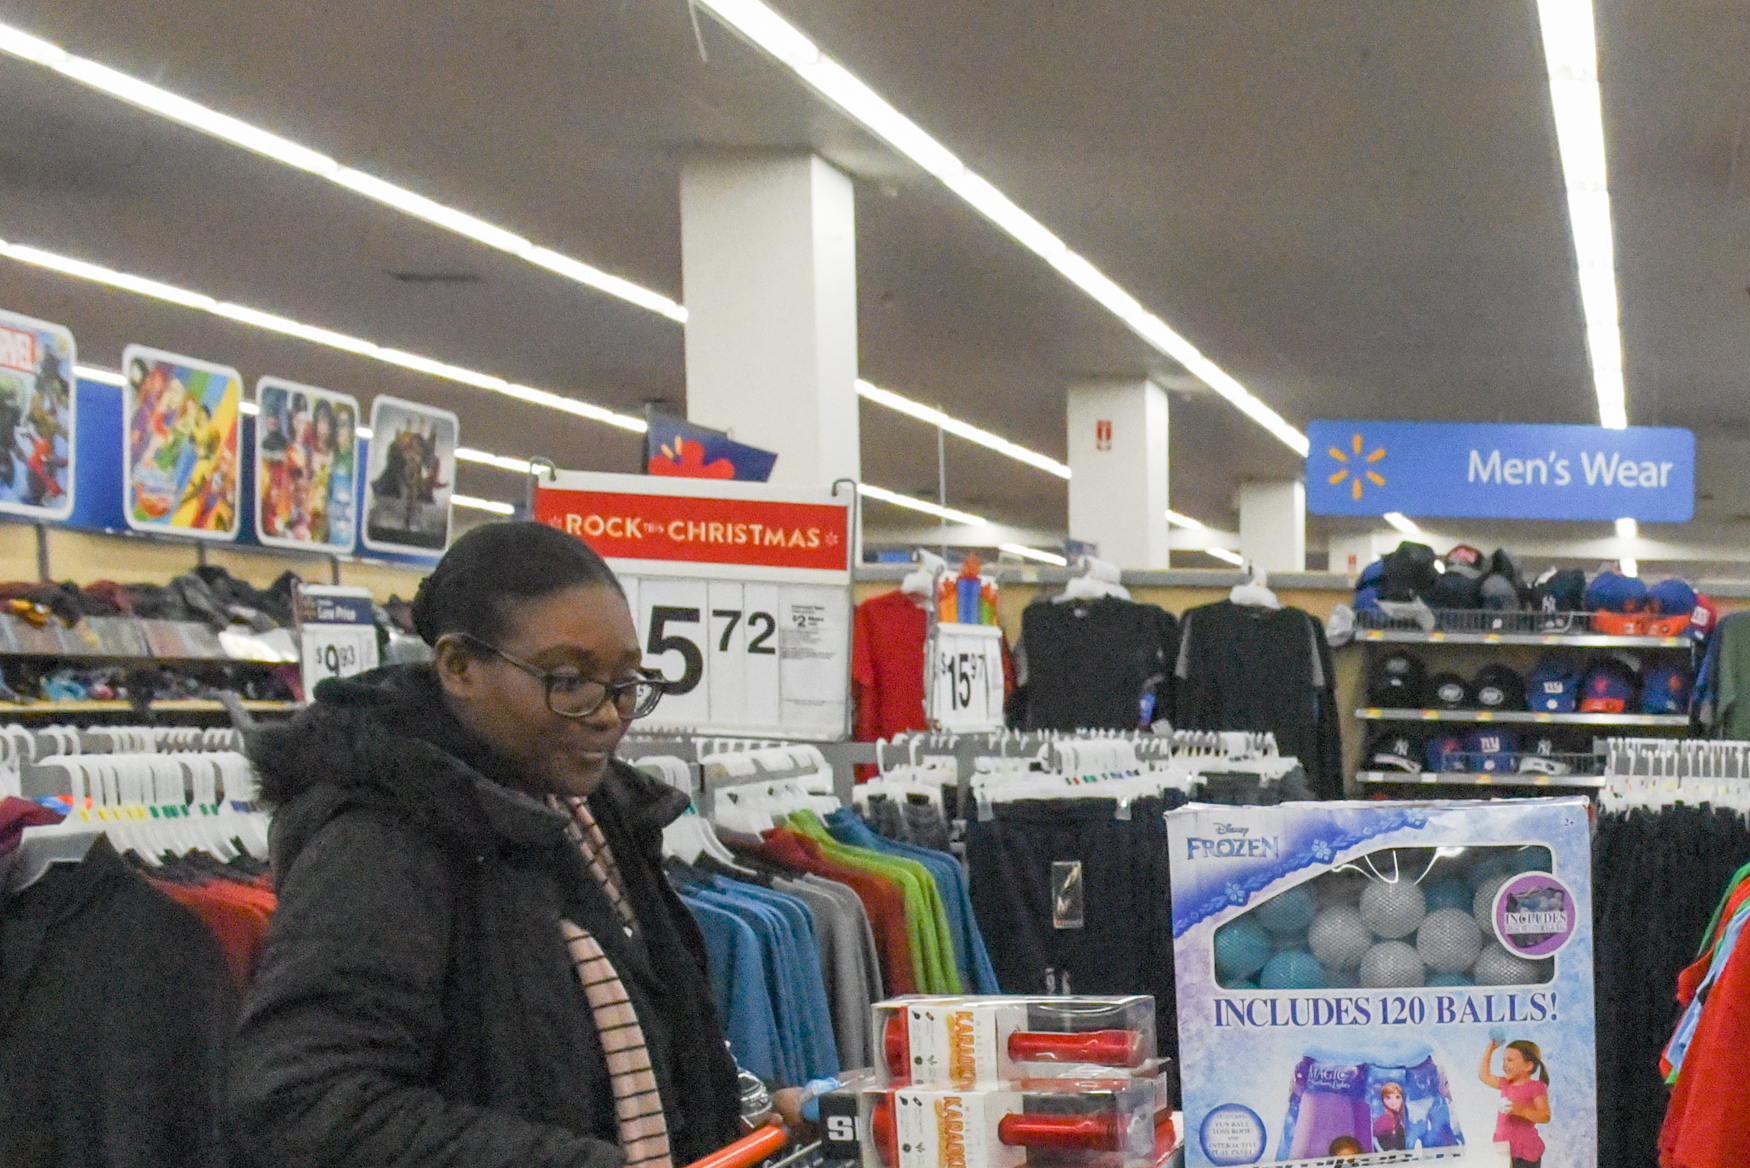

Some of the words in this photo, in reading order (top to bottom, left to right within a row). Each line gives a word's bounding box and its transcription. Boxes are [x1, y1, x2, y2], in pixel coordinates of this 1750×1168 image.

[1468, 449, 1571, 487] Men's
[1580, 451, 1674, 489] Wear
[565, 512, 643, 539] ROCK
[667, 520, 822, 548] CHRISTMAS
[1212, 822, 1249, 838] Disney
[1186, 836, 1280, 860] FROZEN
[1505, 913, 1567, 925] INCLUDES
[1214, 996, 1373, 1028] INCLUDES
[1379, 996, 1426, 1027] 120
[1435, 992, 1559, 1025] BALLS!
